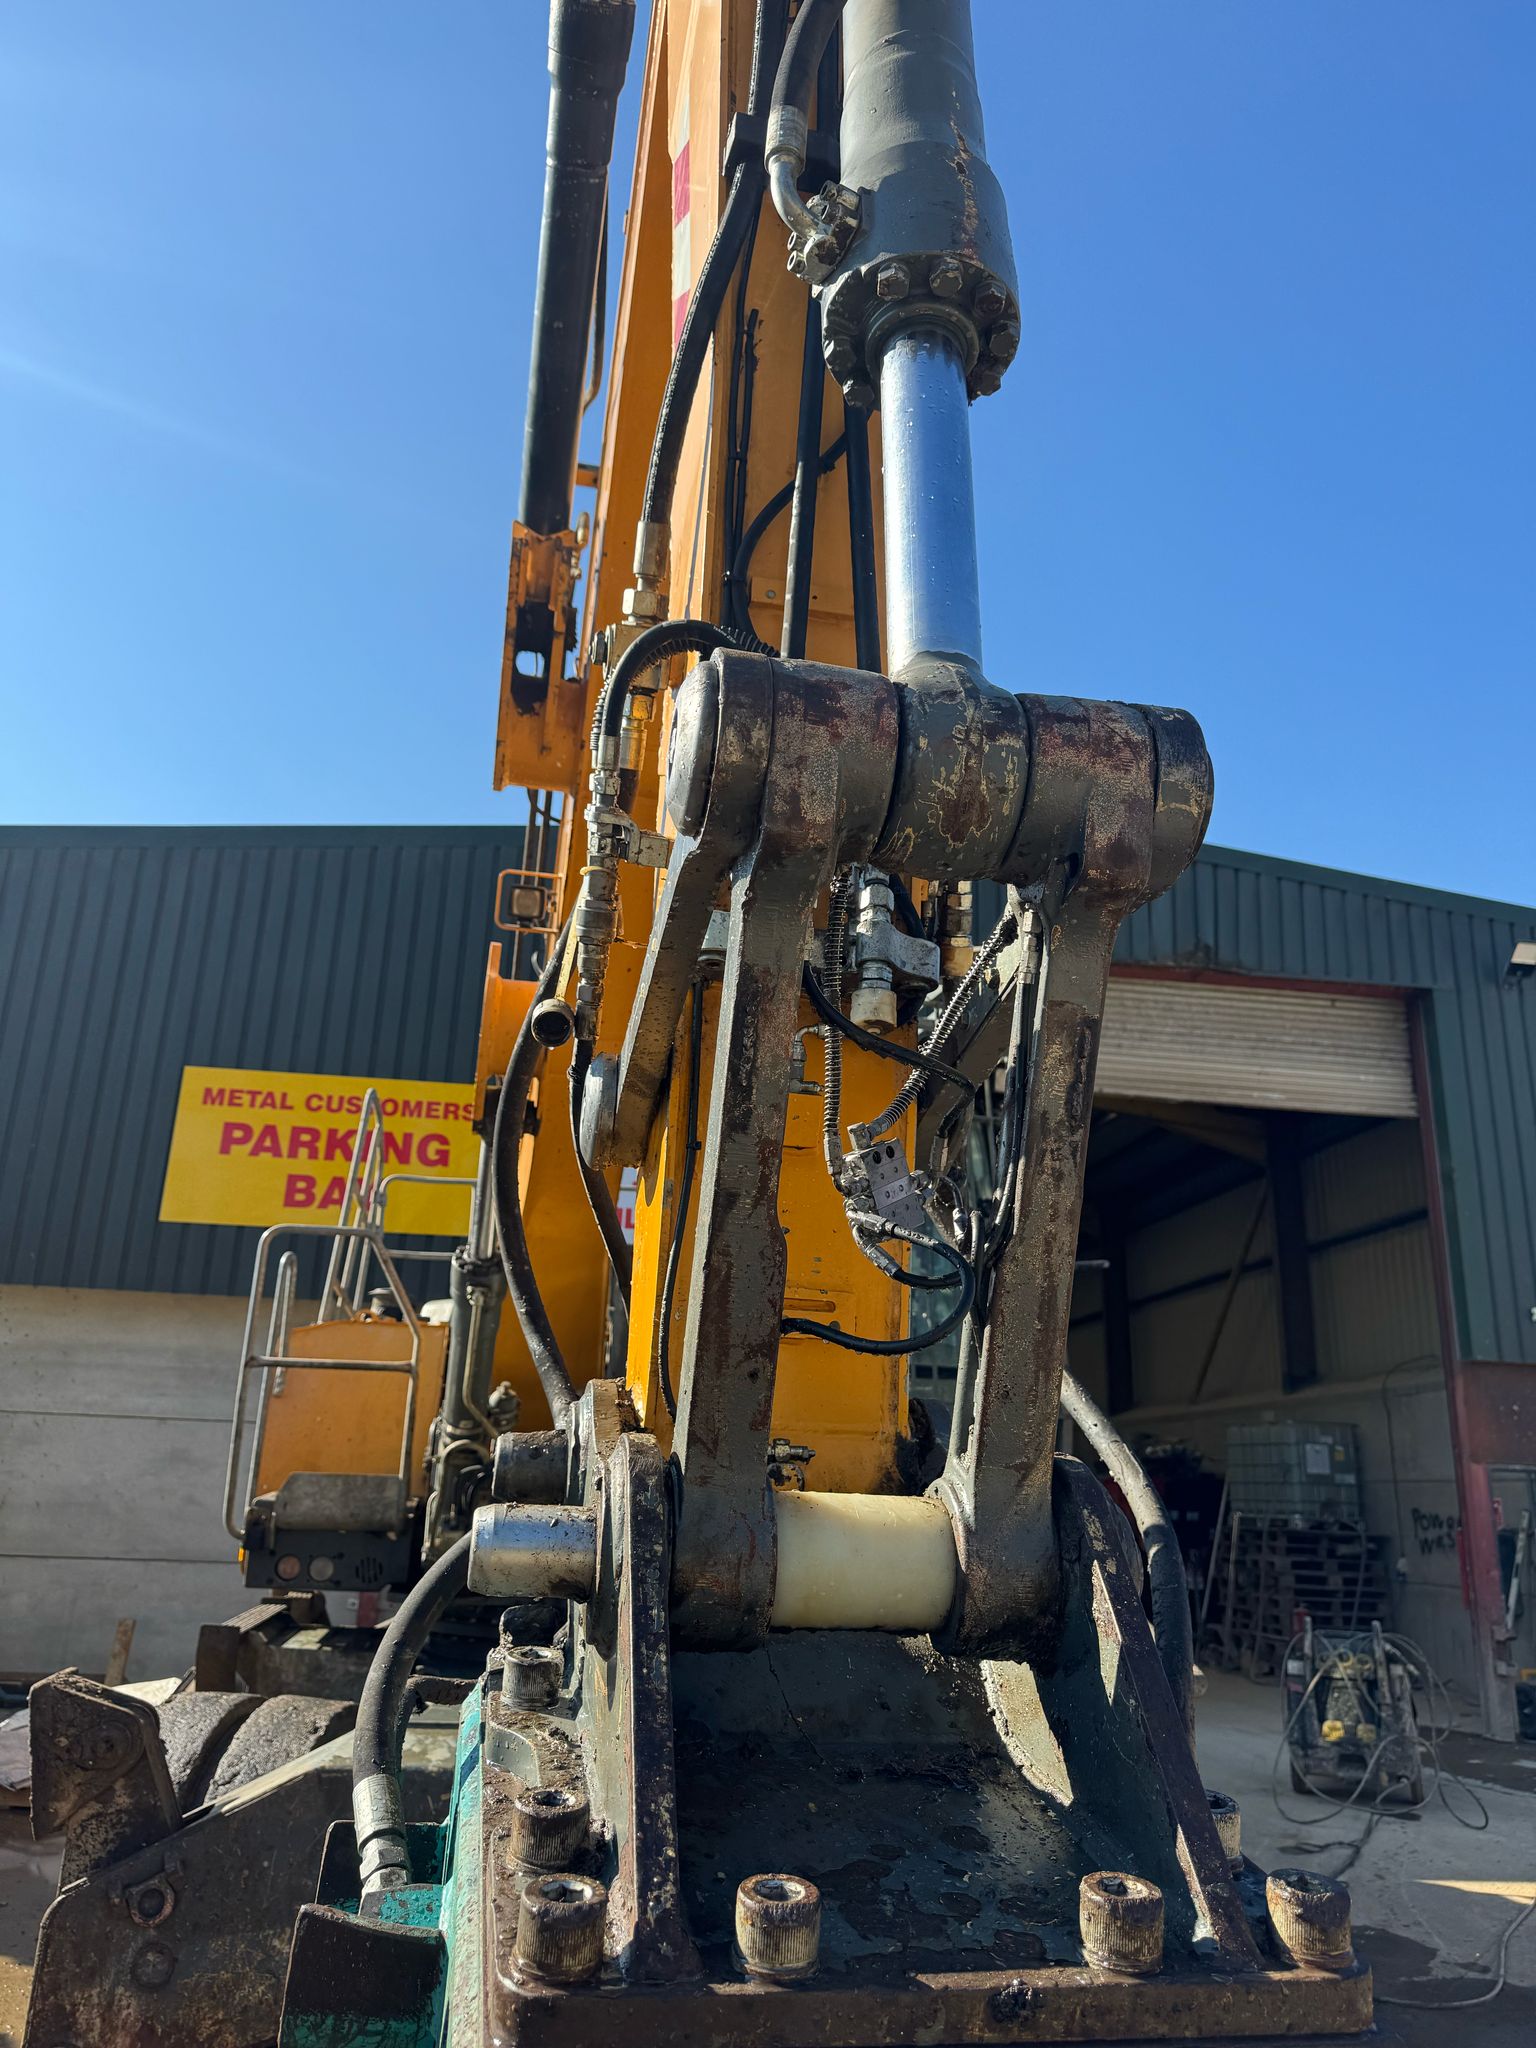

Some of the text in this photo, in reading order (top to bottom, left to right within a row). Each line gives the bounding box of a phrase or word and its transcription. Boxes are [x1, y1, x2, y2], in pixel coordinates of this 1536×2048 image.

[202, 1087, 475, 1121] METAL CUSOMERS
[282, 1173, 375, 1212] BA
